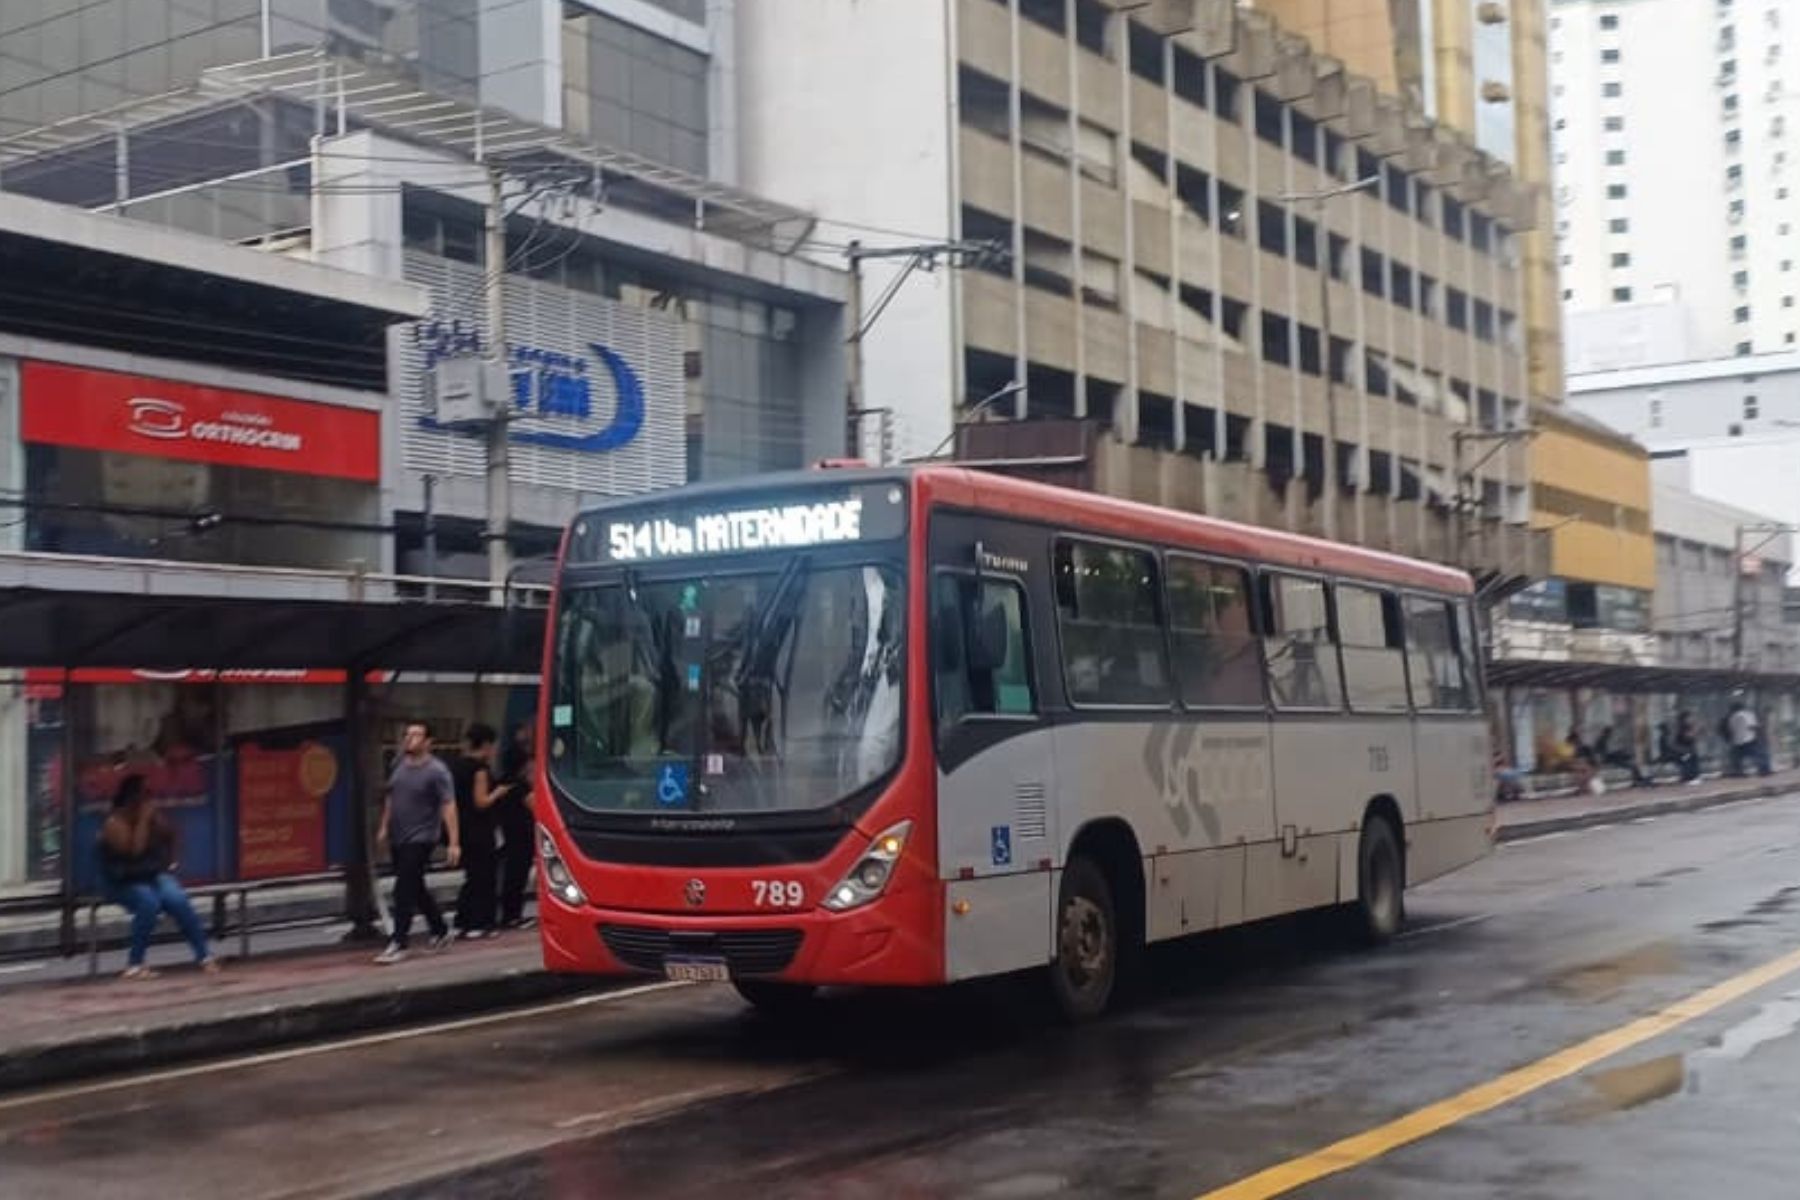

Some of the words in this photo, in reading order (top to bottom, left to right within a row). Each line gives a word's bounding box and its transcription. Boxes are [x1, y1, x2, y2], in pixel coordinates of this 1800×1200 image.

[609, 522, 651, 560] 514
[696, 499, 862, 551] MATERNIDADE
[752, 880, 804, 906] 789
